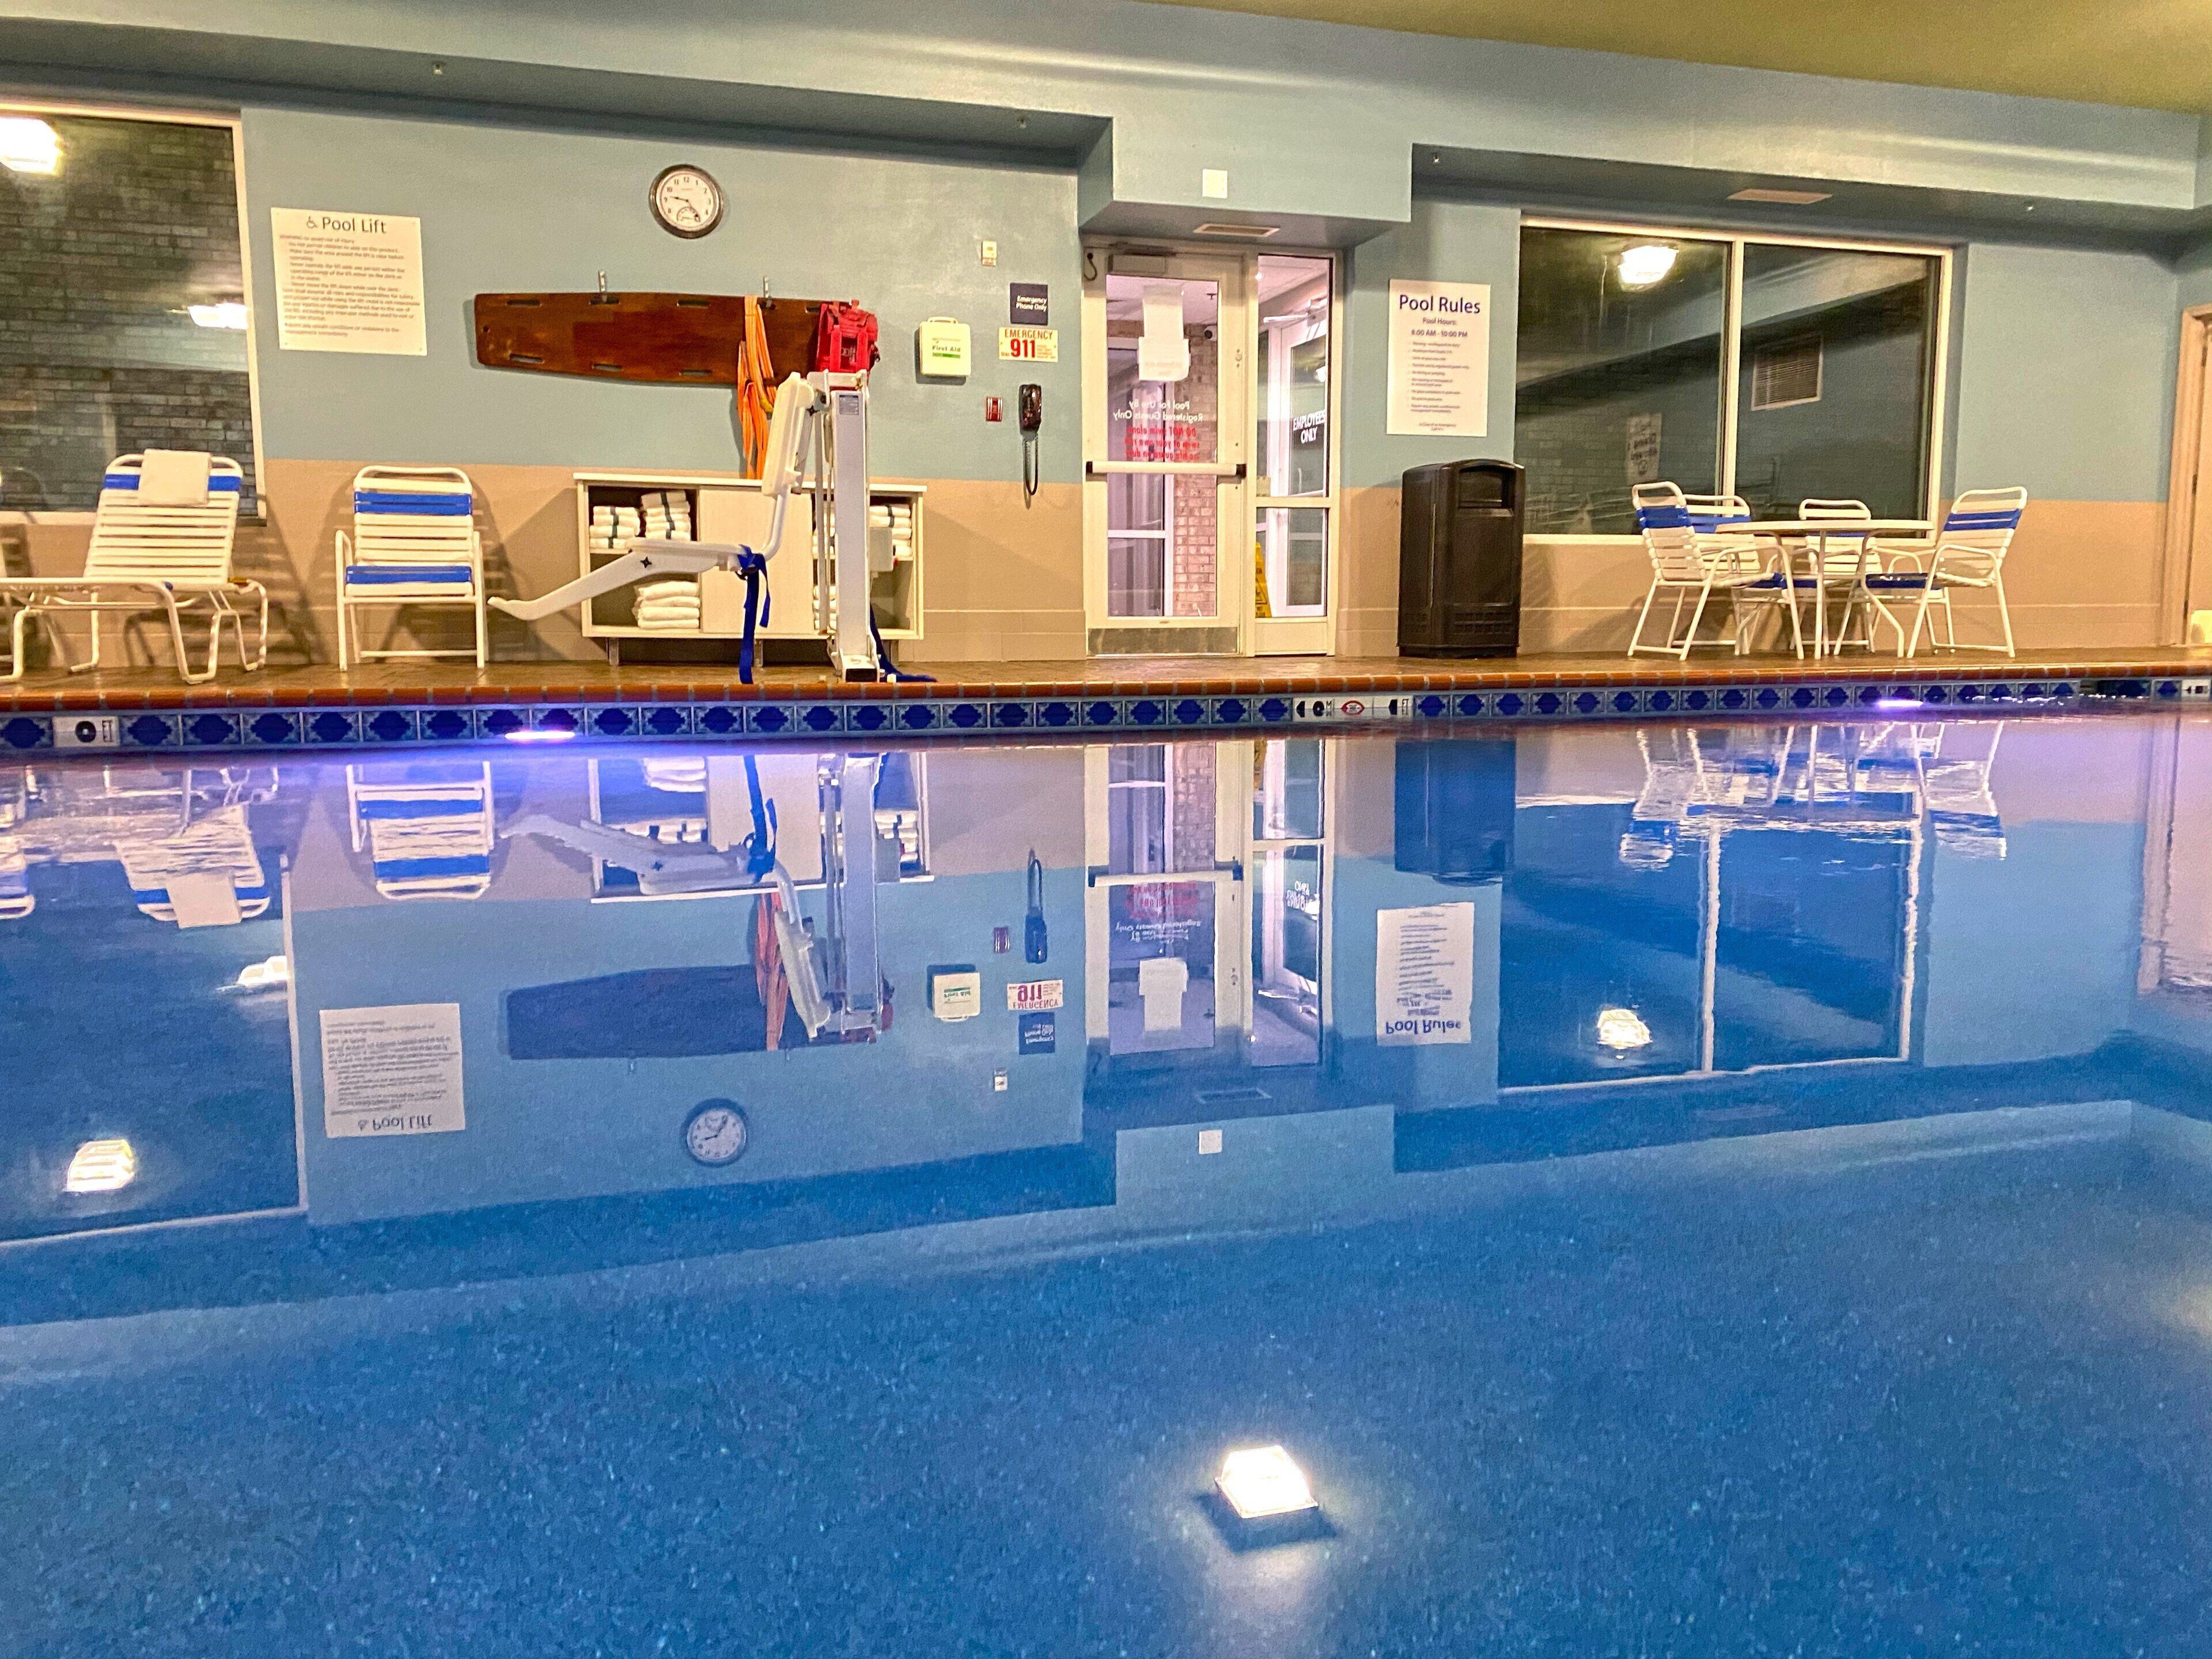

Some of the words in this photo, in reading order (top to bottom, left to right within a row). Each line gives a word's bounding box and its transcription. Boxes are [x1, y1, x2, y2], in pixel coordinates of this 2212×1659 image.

[322, 216, 355, 232] Pool
[362, 219, 387, 234] Lift
[1017, 295, 1047, 305] Emergency
[1034, 303, 1047, 312] Only
[1400, 294, 1433, 311] Pool
[1439, 297, 1480, 313] Rules
[1005, 329, 1053, 340] EMERGENCY
[1010, 338, 1036, 358] 911
[1293, 408, 1325, 431] EMPLOYEES
[1301, 426, 1318, 444] ONLY
